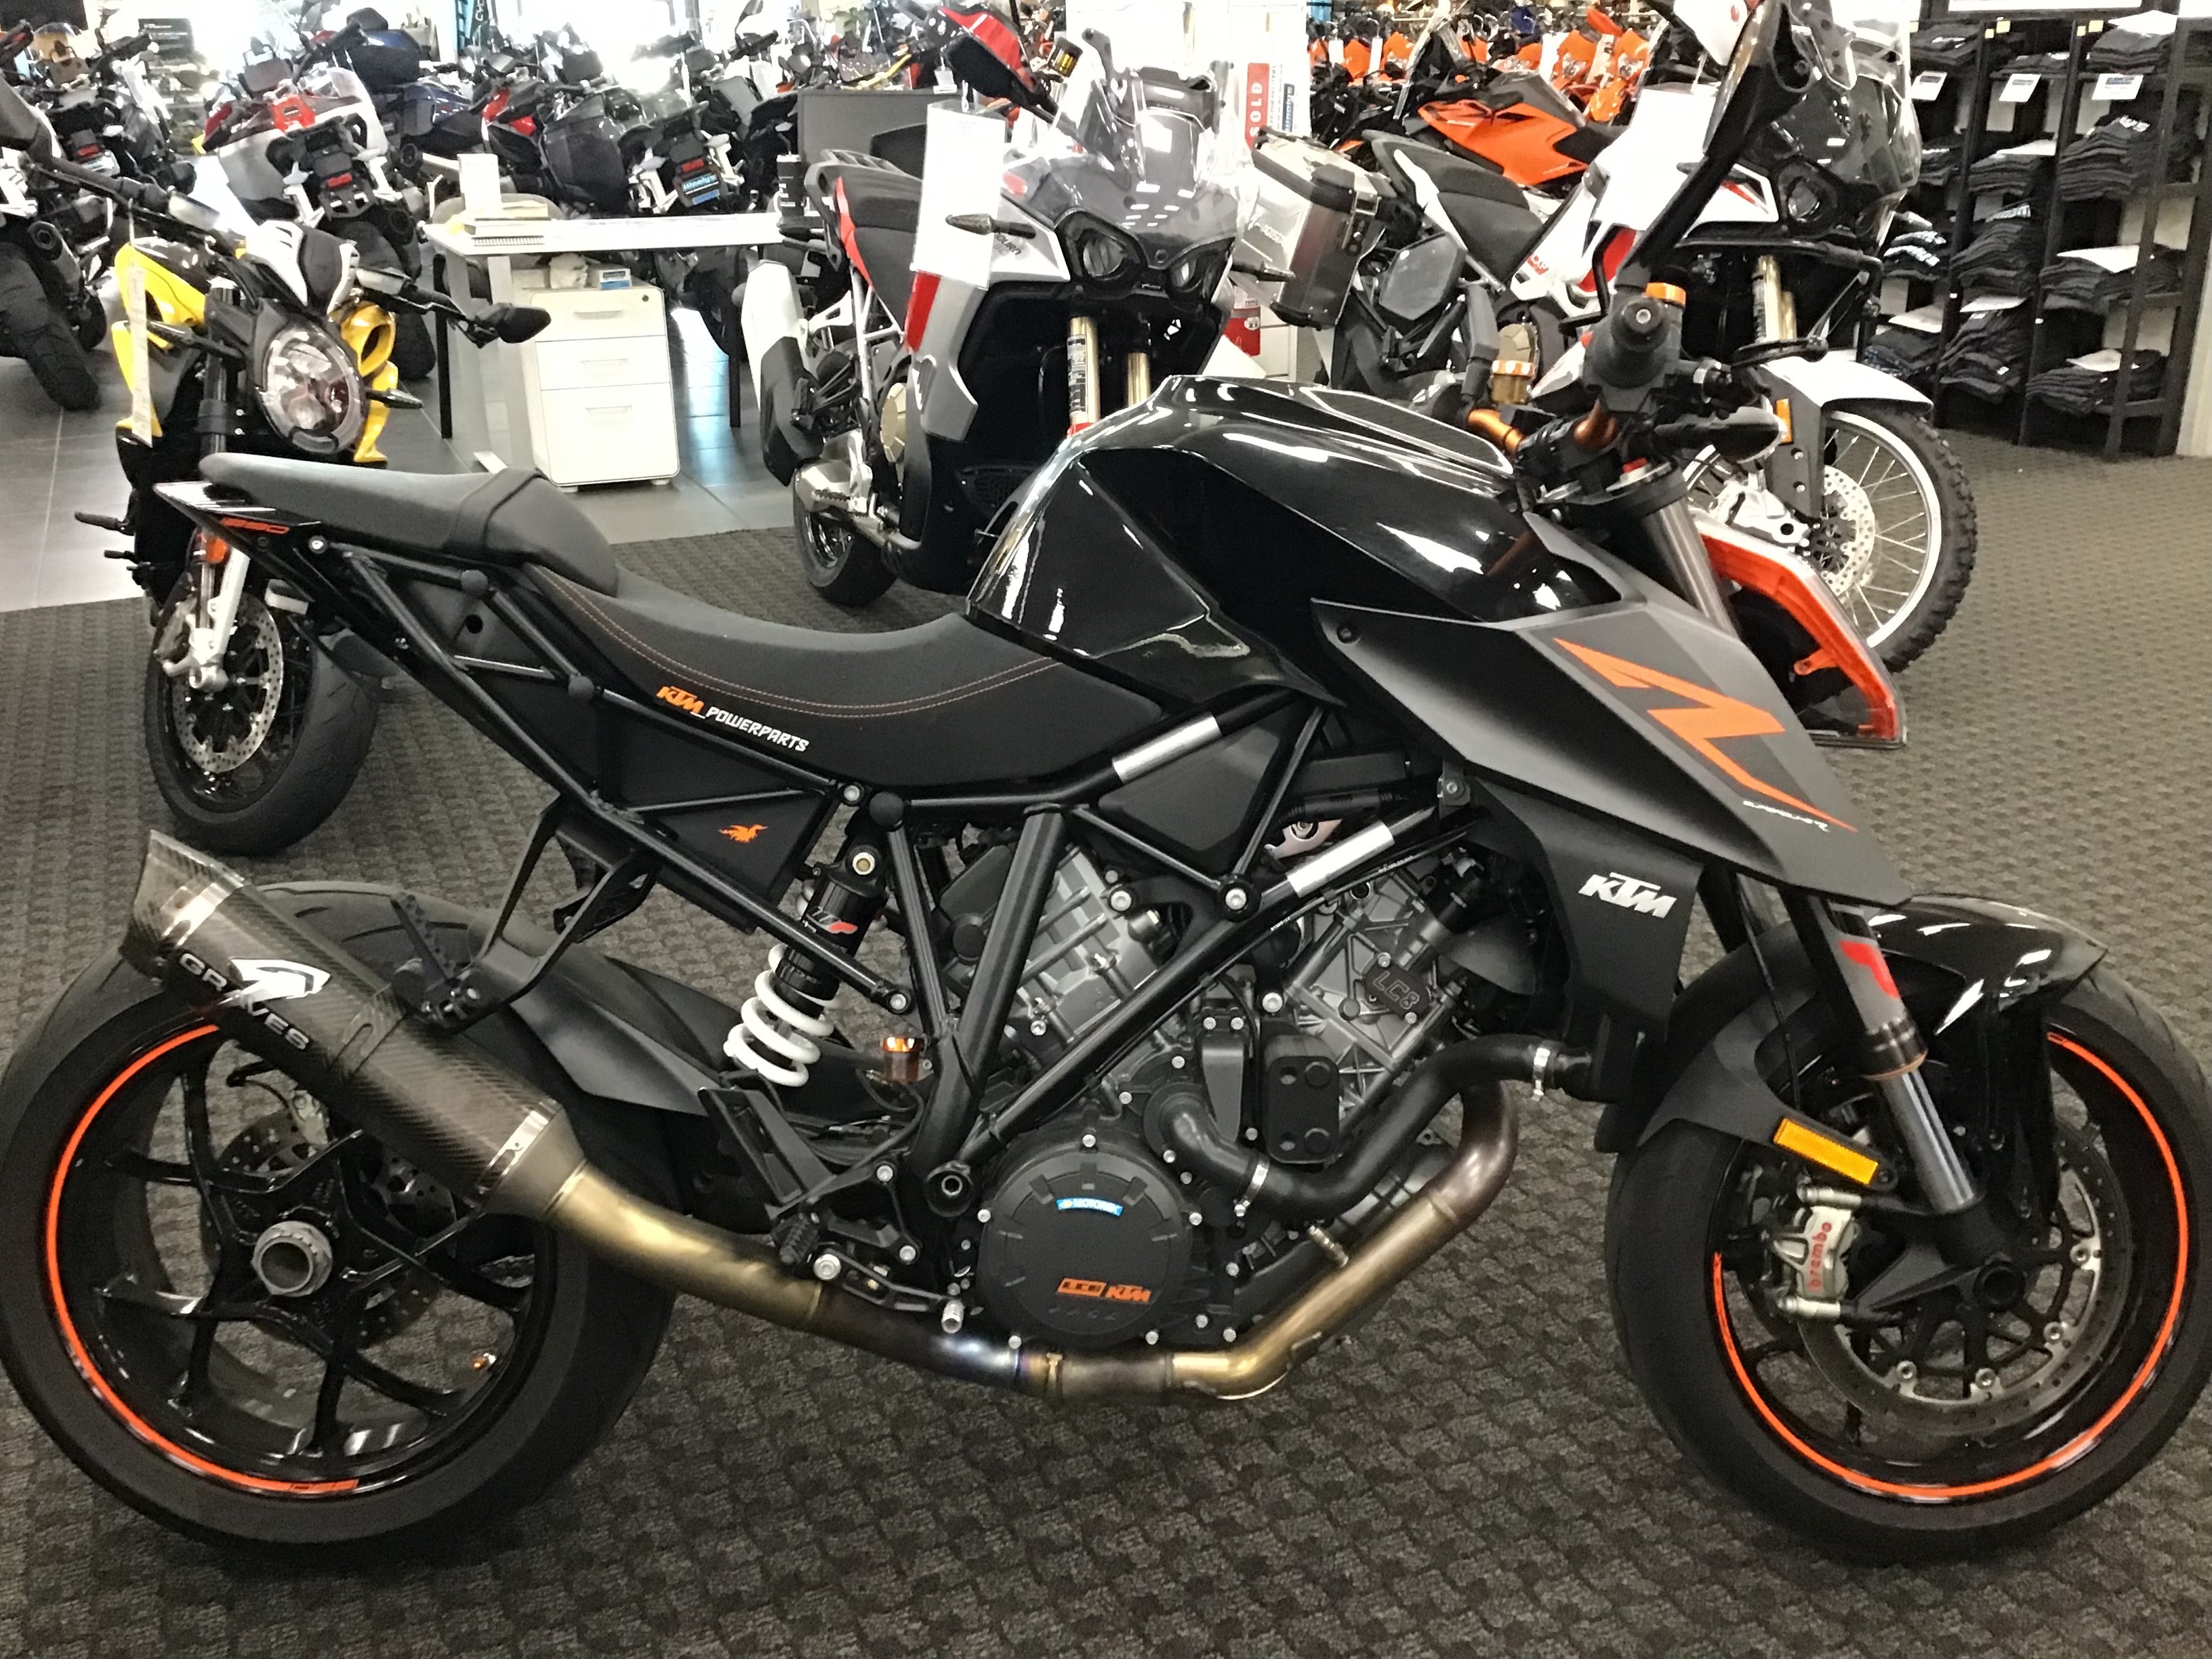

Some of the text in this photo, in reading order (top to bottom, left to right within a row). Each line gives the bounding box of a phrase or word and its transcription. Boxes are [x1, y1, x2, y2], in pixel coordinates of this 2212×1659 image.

[1248, 82, 1263, 137] SOLD
[656, 679, 809, 752] KTM POWERPARTS
[1578, 872, 1677, 919] KTM
[1372, 970, 1420, 1010] LC8
[1807, 1222, 1832, 1291] brembo
[1105, 1284, 1151, 1303] KTM
